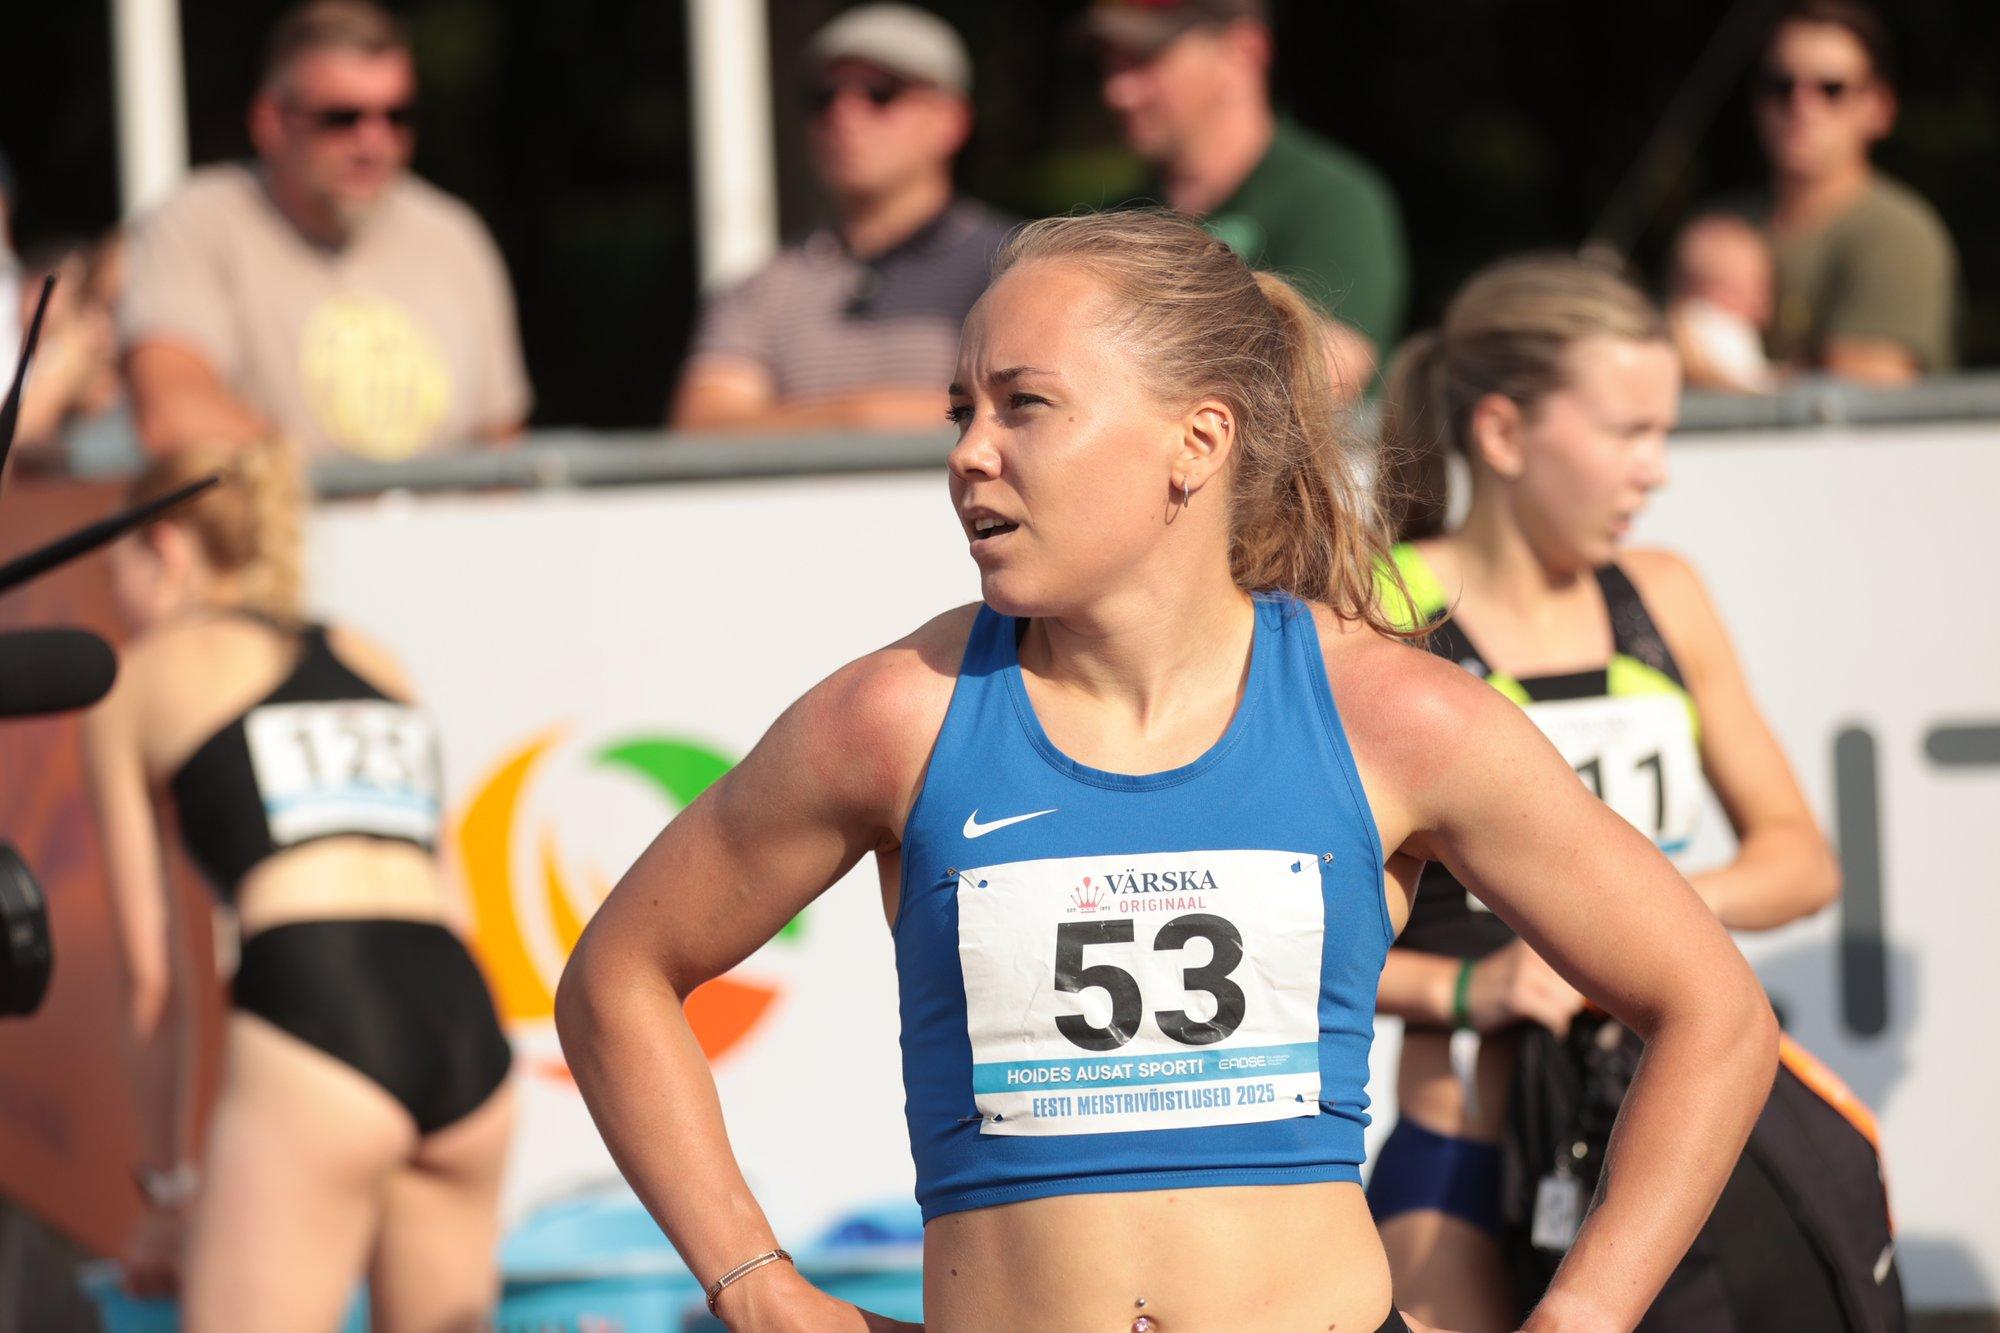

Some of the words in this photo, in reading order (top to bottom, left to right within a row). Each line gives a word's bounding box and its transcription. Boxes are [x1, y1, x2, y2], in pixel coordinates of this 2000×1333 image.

[1104, 868, 1219, 895] VÄRSKA
[1119, 896, 1207, 914] ORIGINAAL
[1054, 913, 1246, 1052] 53
[1007, 1067, 1072, 1085] HOIDES
[1076, 1063, 1134, 1081] AUSAT
[1138, 1058, 1203, 1078] SPORTI
[1033, 1096, 1072, 1118] EESTI
[1237, 1083, 1275, 1106] 2025
